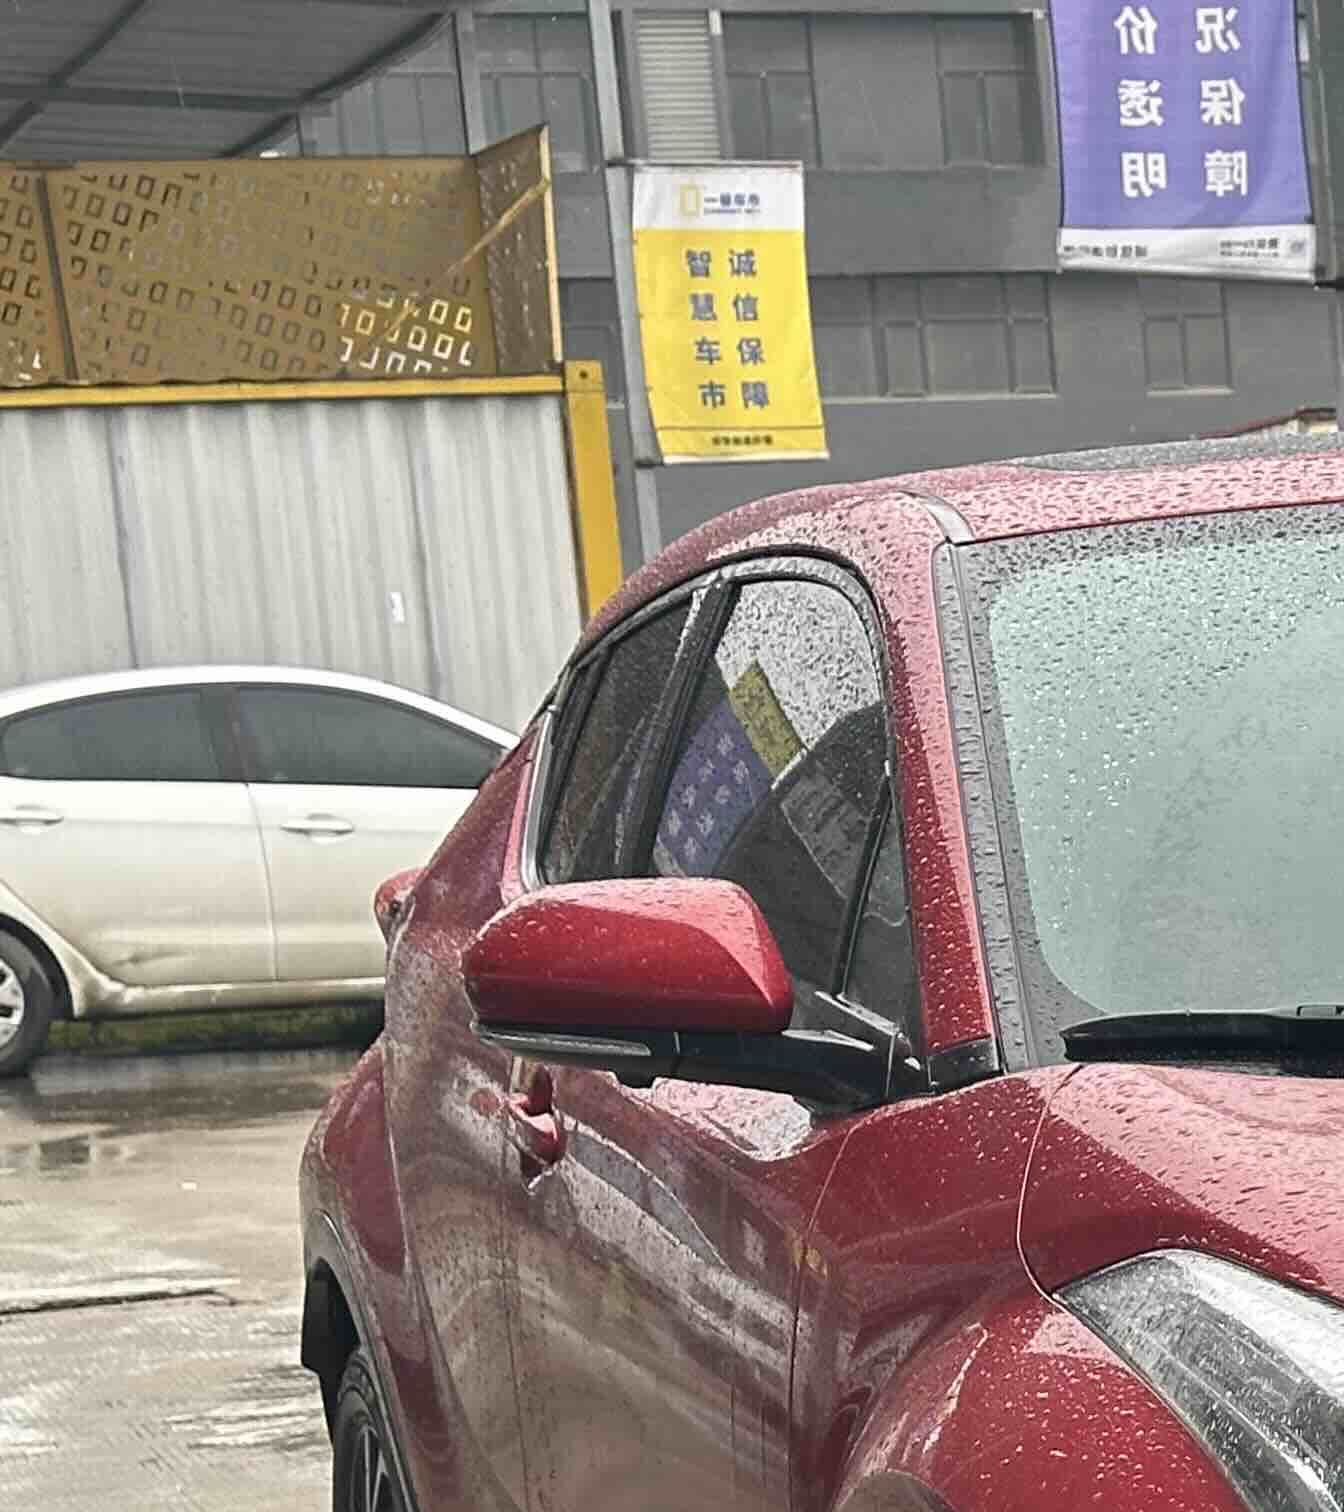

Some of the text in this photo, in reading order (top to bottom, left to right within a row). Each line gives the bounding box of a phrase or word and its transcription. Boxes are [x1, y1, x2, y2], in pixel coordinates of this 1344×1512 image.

[685, 250, 727, 409] 智慧车市
[728, 250, 770, 409] 诚信保障
